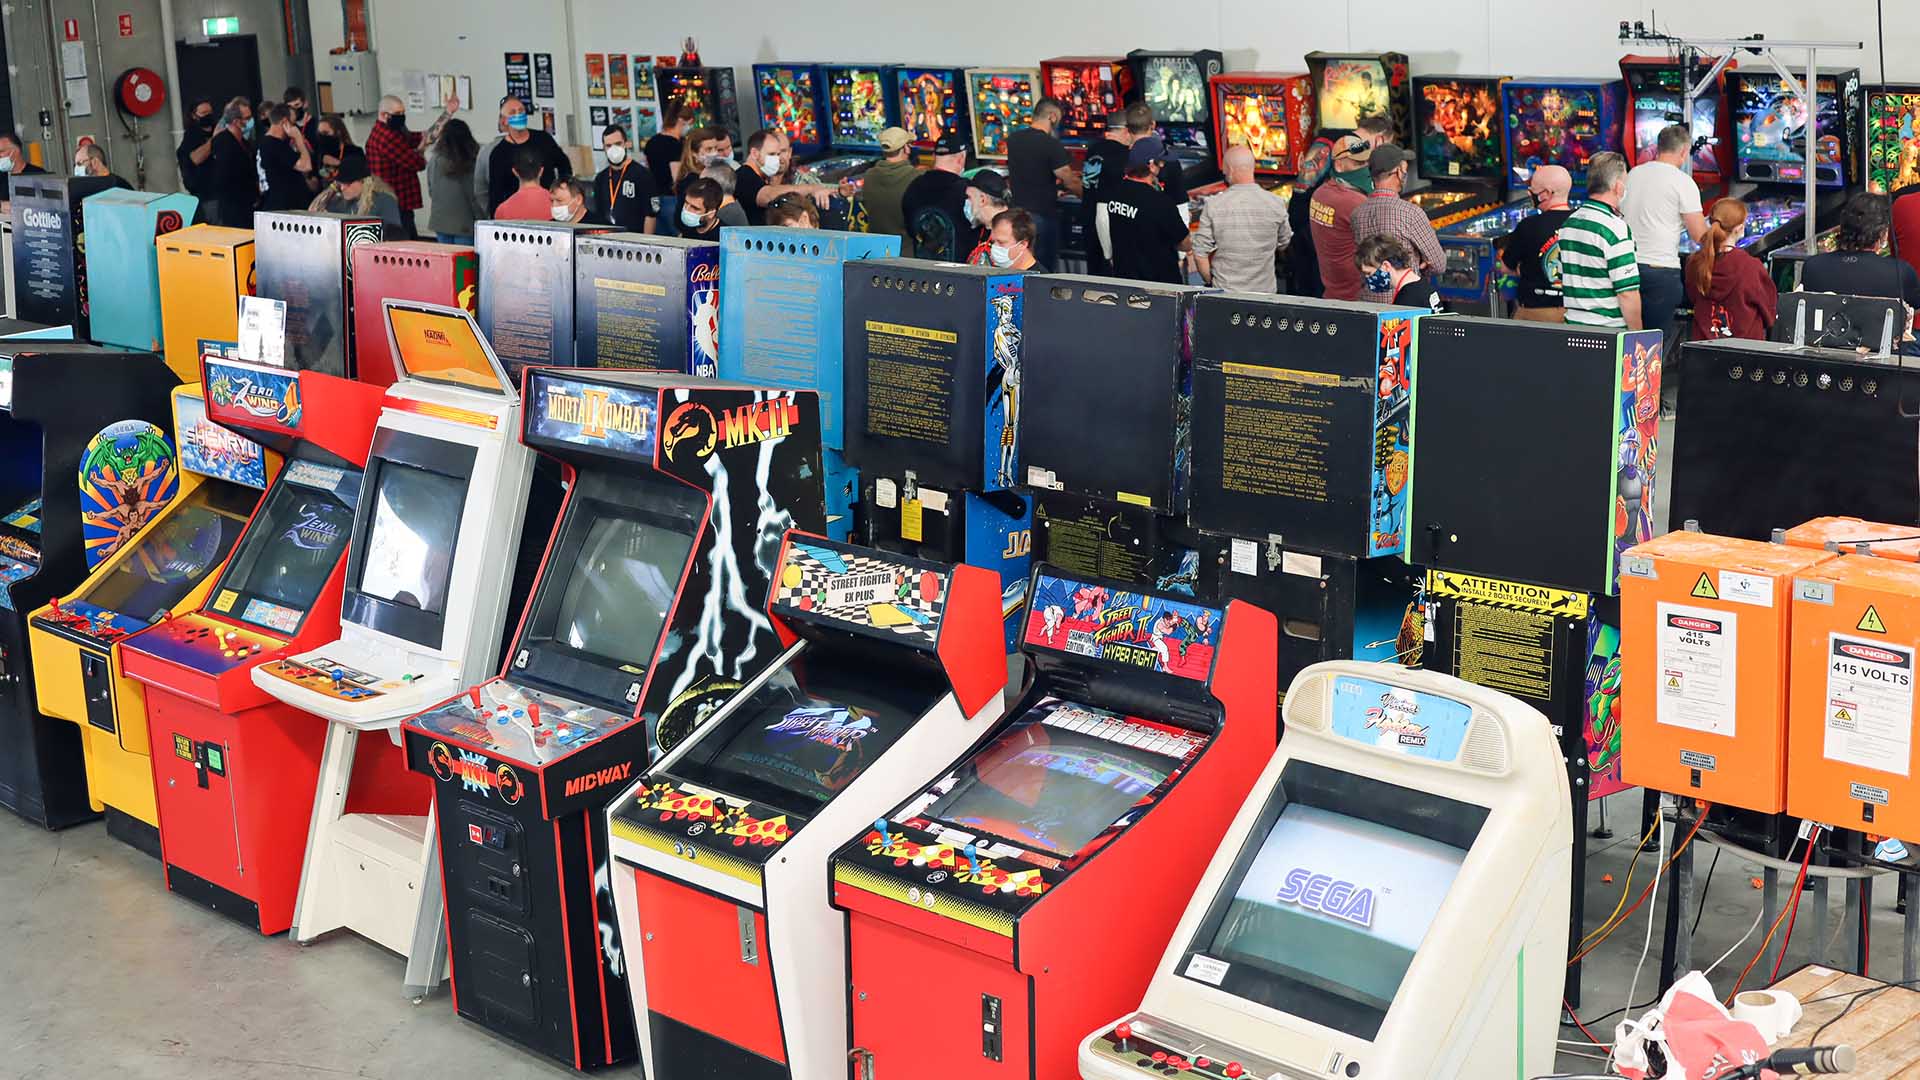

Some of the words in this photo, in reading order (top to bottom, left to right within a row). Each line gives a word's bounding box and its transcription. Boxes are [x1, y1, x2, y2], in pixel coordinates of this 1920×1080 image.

[23, 207, 62, 229] Gottlieb
[1108, 200, 1138, 219] CREW
[696, 363, 715, 378] NBA
[231, 376, 274, 409] ZERO
[830, 577, 859, 591] STREET
[859, 572, 892, 588] FIGHTER
[1461, 577, 1550, 600] ATTENTION
[844, 592, 854, 603] EX
[855, 589, 875, 602] PLUS
[1461, 588, 1486, 597] INSTALL
[1493, 592, 1513, 601] BOLTS
[1514, 595, 1550, 607] SECURELY!
[1098, 606, 1142, 627] STREET
[1678, 618, 1711, 629] DANGER
[1068, 629, 1094, 645] CHAMPION
[1093, 620, 1136, 648] FIGHTER
[1679, 636, 1711, 647] VOLTS
[1686, 630, 1704, 639] 415
[1066, 640, 1086, 654] EDITION
[1102, 644, 1131, 664] HYPER
[1130, 648, 1157, 668] FIGHT
[1849, 646, 1894, 662] DANGER
[1833, 662, 1857, 675] 415
[1861, 666, 1909, 686] VOLTS
[1399, 735, 1426, 746] REMIX
[564, 761, 632, 798] MIDWAY
[1275, 867, 1374, 928] SEGA
